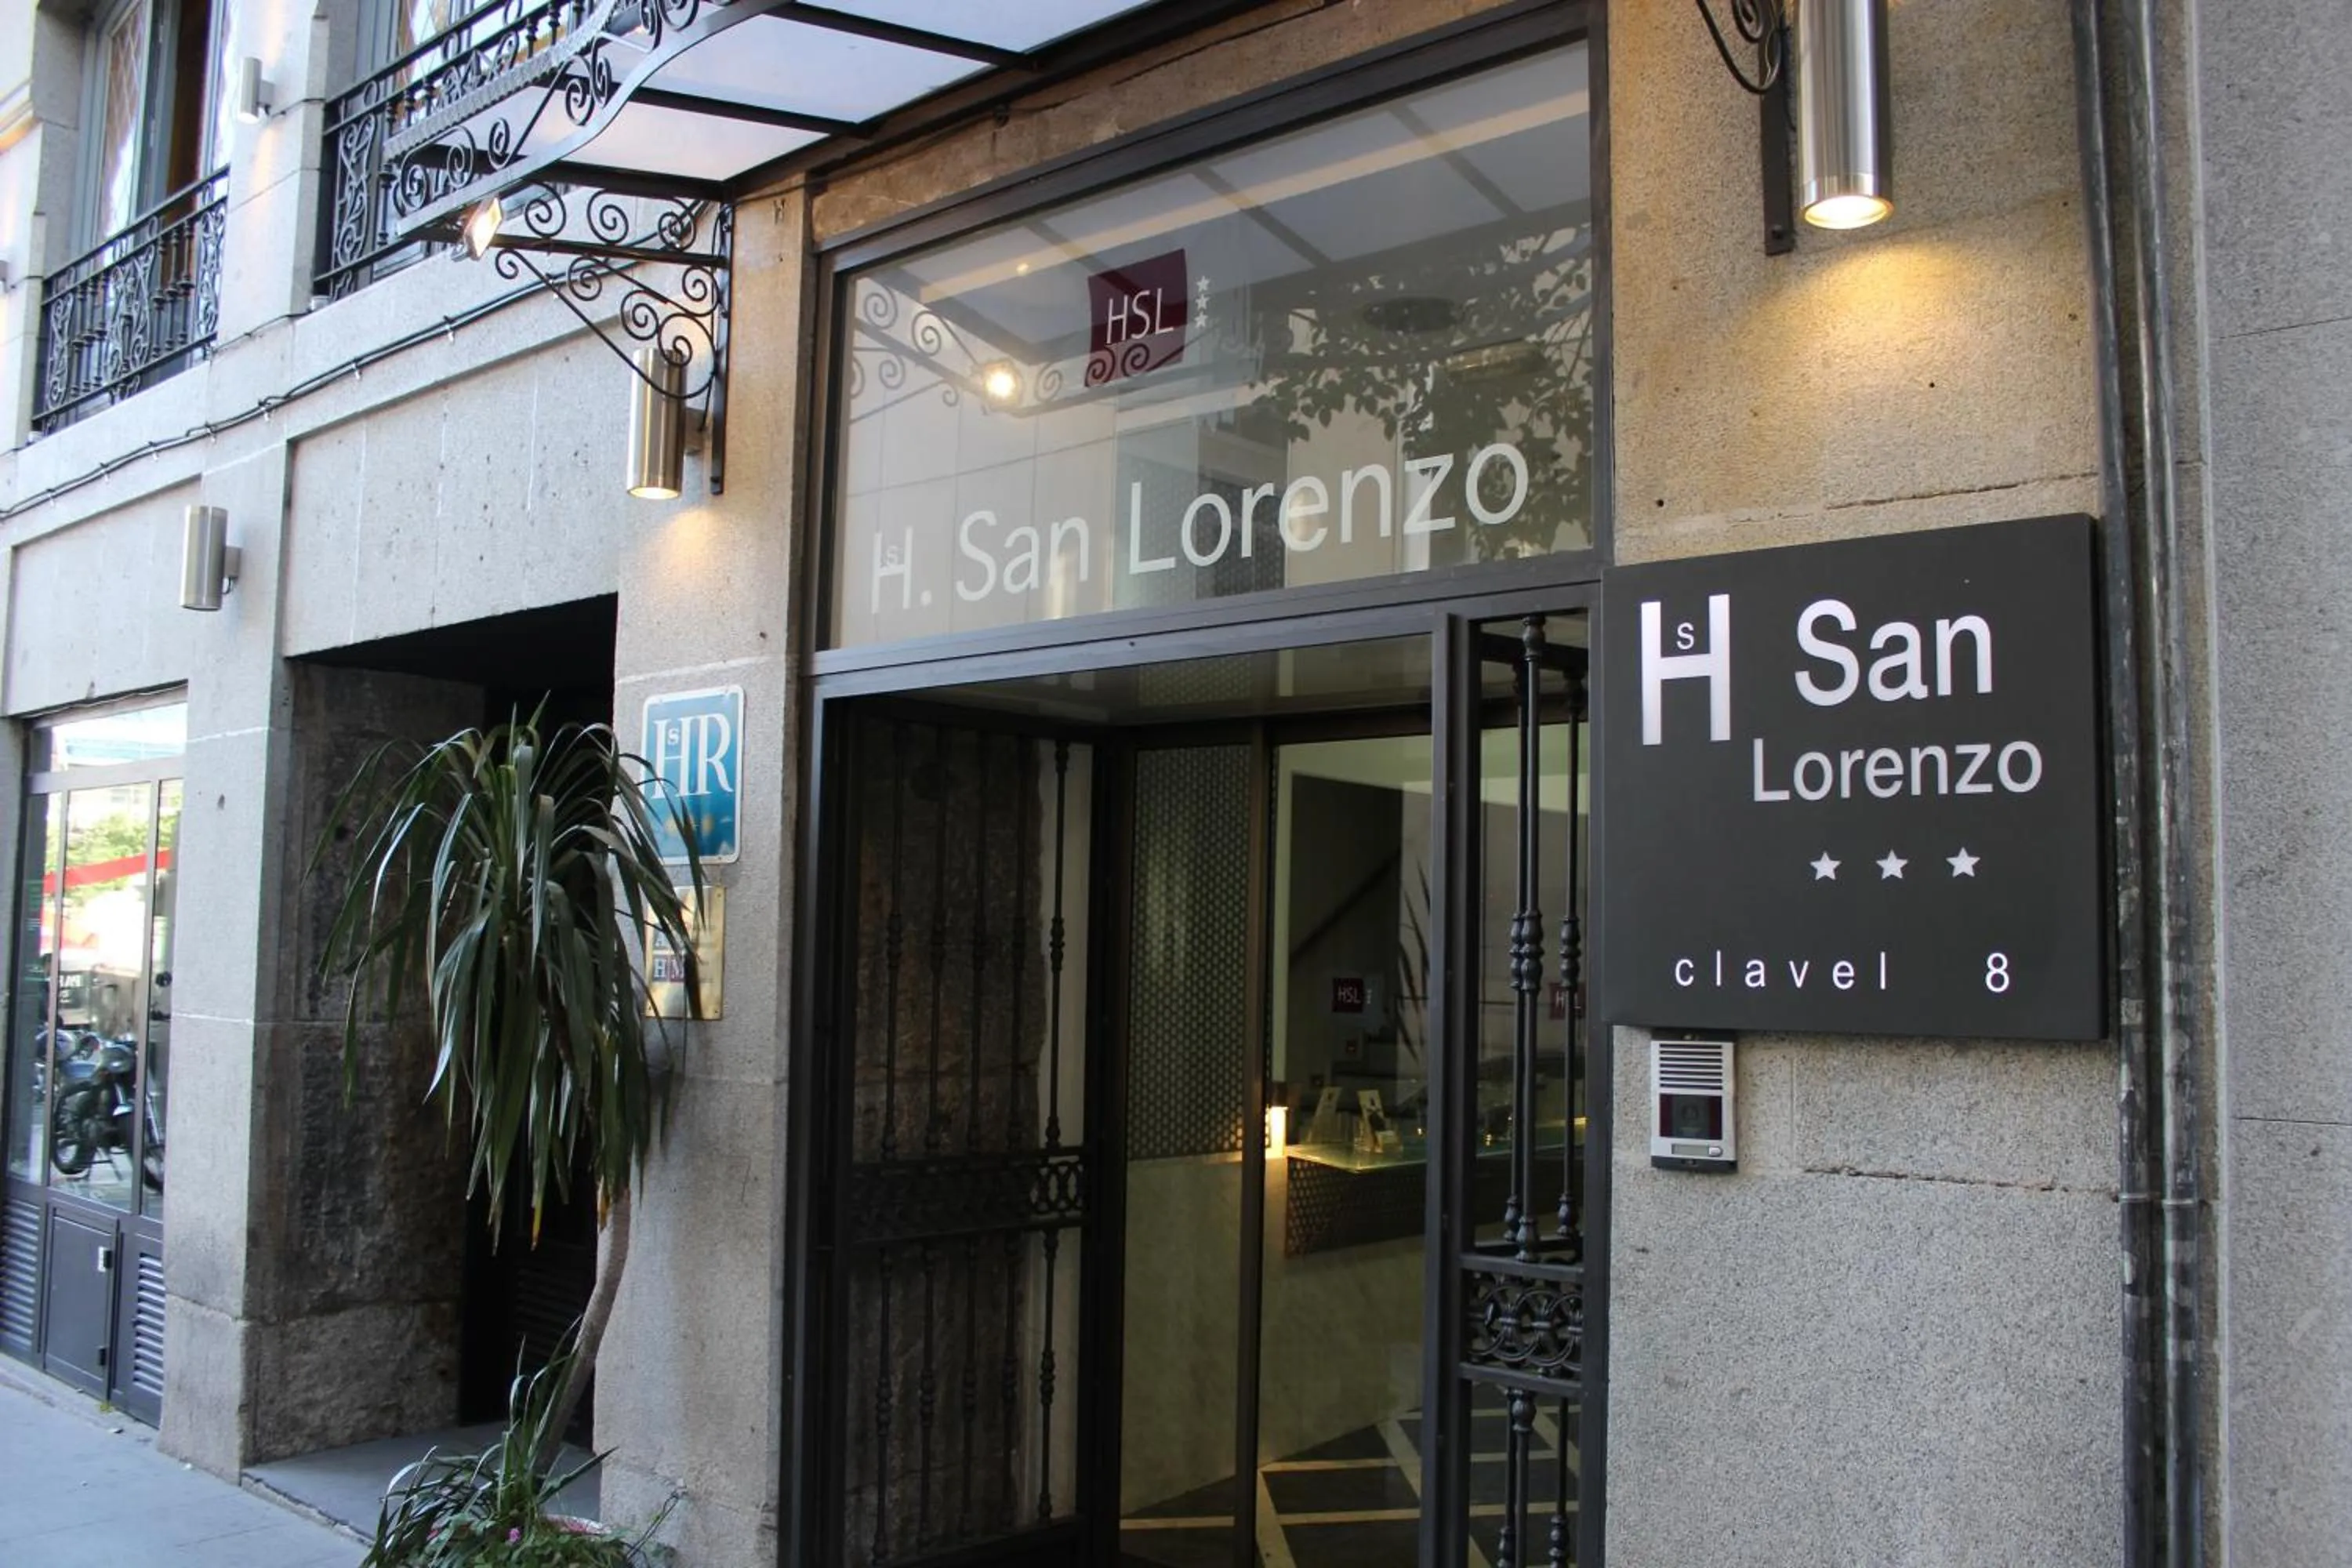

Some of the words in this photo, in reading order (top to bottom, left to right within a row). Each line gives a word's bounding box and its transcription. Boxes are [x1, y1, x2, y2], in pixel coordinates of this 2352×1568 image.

[1106, 288, 1174, 344] HSL
[956, 510, 1091, 602] San
[1128, 442, 1530, 575] Lorenzo
[1641, 593, 1731, 746] H
[1795, 598, 1993, 706] San
[1753, 738, 2042, 802] Lorenzo
[1338, 985, 1362, 1004] HSL
[1675, 950, 1886, 990] clavel
[1984, 953, 2010, 993] 8
[1555, 990, 1582, 1010] HL
